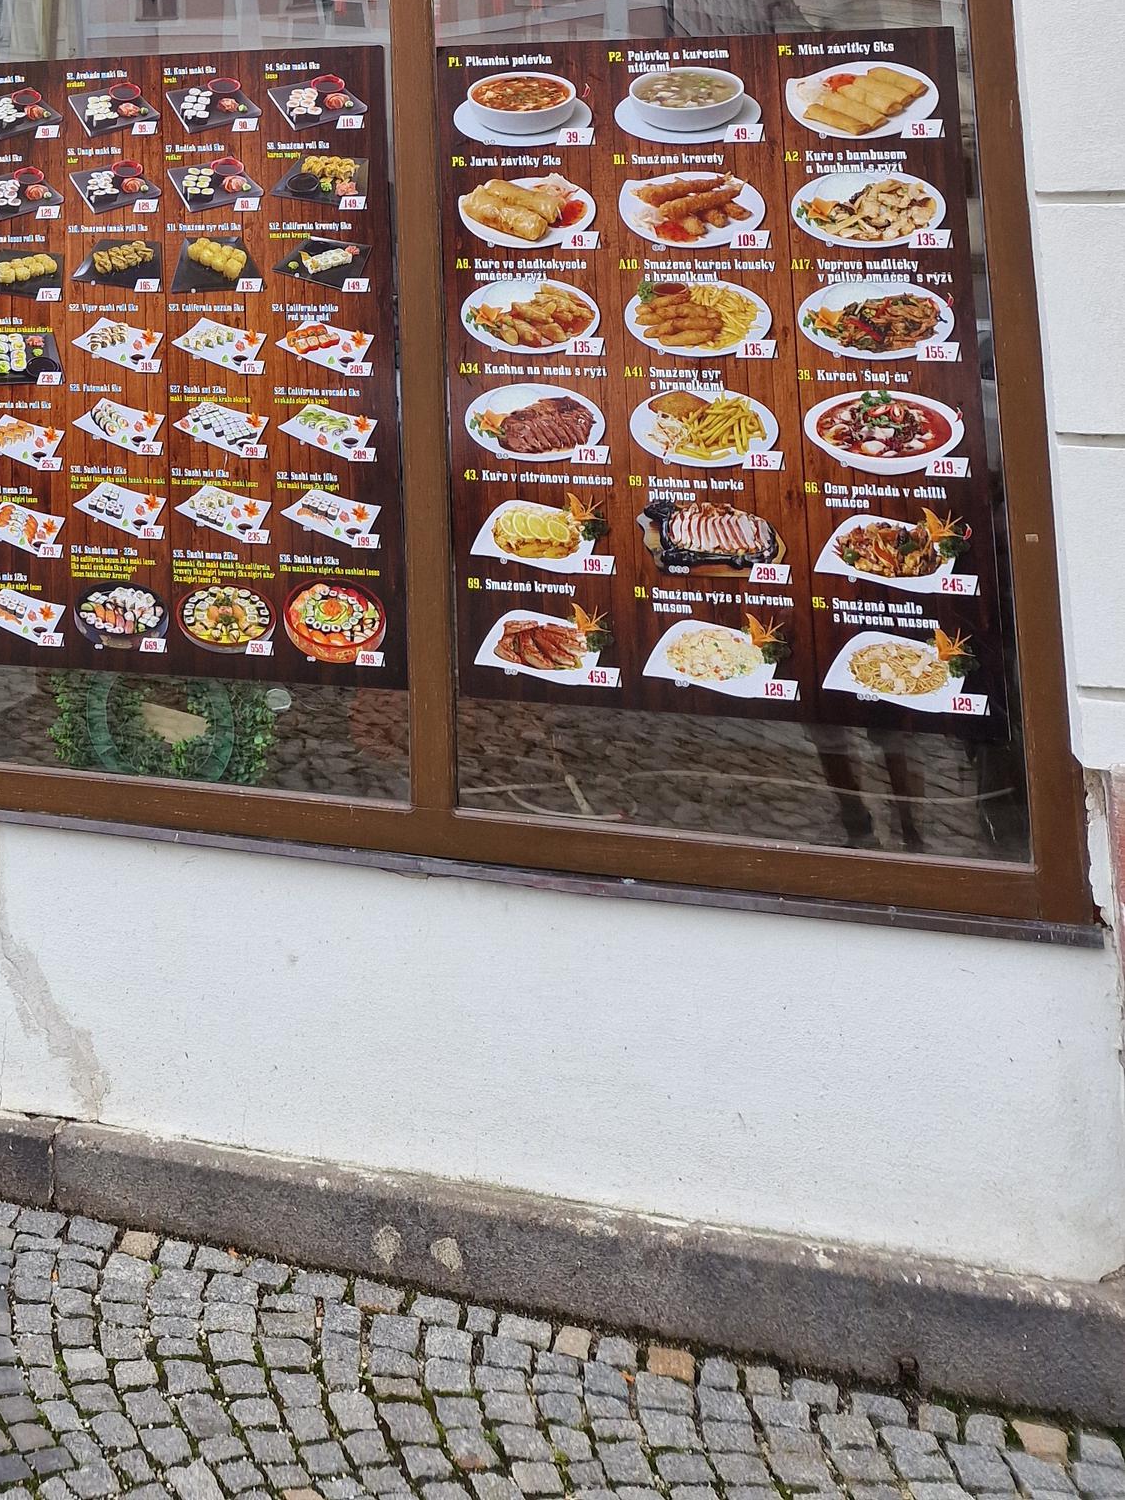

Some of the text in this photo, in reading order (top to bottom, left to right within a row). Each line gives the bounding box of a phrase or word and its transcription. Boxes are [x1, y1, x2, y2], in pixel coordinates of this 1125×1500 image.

[778, 41, 894, 56] P5. Mini závitky 6ks
[448, 55, 552, 67] P1. Pikantní polévka
[609, 52, 624, 62] P2.
[628, 50, 670, 62] Polévka
[628, 62, 671, 73] nitkami
[734, 128, 754, 140] 49.-
[911, 124, 933, 136] 58.-
[566, 132, 585, 143] 39.-
[452, 156, 561, 168] P6. Jarní závitky 2ks
[613, 153, 724, 165] B1. Smažené krevety
[785, 150, 907, 162] A2. Kuře s bambusem
[806, 165, 813, 173] a
[816, 163, 866, 173] houbami
[878, 163, 903, 175] rýží
[571, 235, 590, 247] 49.-
[737, 234, 763, 247] 109.-
[917, 233, 943, 246] 135.-
[456, 259, 471, 269] A8.
[475, 258, 500, 269] Kuře
[503, 261, 514, 269] ve
[619, 259, 775, 271] A10. Smažené kuřecí kousky
[791, 258, 918, 272] A17. Vepřové nudličky
[475, 271, 547, 283] omáčce s rýží
[644, 271, 718, 282] s hranolkami
[818, 271, 953, 284] v pálivé omáčce s rýží
[573, 341, 597, 353] 135.-
[744, 343, 769, 356] 135.-
[925, 345, 952, 359] 155.-
[459, 363, 607, 378] A34. Kachna na medu s rýží
[624, 366, 721, 380] A41. Smažený sýr
[798, 370, 813, 381] 38.
[817, 369, 857, 382] Kuřecí
[660, 380, 724, 390] hranolkami
[578, 450, 602, 462] 179.-
[750, 454, 775, 467] 135.-
[934, 461, 961, 474] 219.-
[464, 470, 478, 481] 43.
[482, 470, 508, 482] Kuře
[511, 474, 517, 482] v
[573, 475, 613, 485] omáčce
[629, 475, 744, 490] 69. Kachna na horké
[649, 489, 696, 502] plotýnce
[805, 482, 821, 493] 86.
[824, 483, 848, 495] Osm
[903, 489, 910, 497] v
[913, 486, 946, 499] chilli
[825, 497, 869, 509] omáčce
[583, 558, 608, 571] 199.-
[756, 567, 784, 581] 299.-
[467, 578, 576, 597] 89. Smažené krevety
[941, 578, 971, 592] 245.-
[635, 586, 793, 607] 91. Smažená rýže s kuřecím
[653, 602, 692, 614] masem
[812, 597, 923, 615] 95. Smažené nudle
[834, 613, 940, 629] s kuřecím masem
[587, 670, 613, 684] 459.-
[764, 683, 791, 697] 129.-
[952, 697, 979, 712] 129.-
